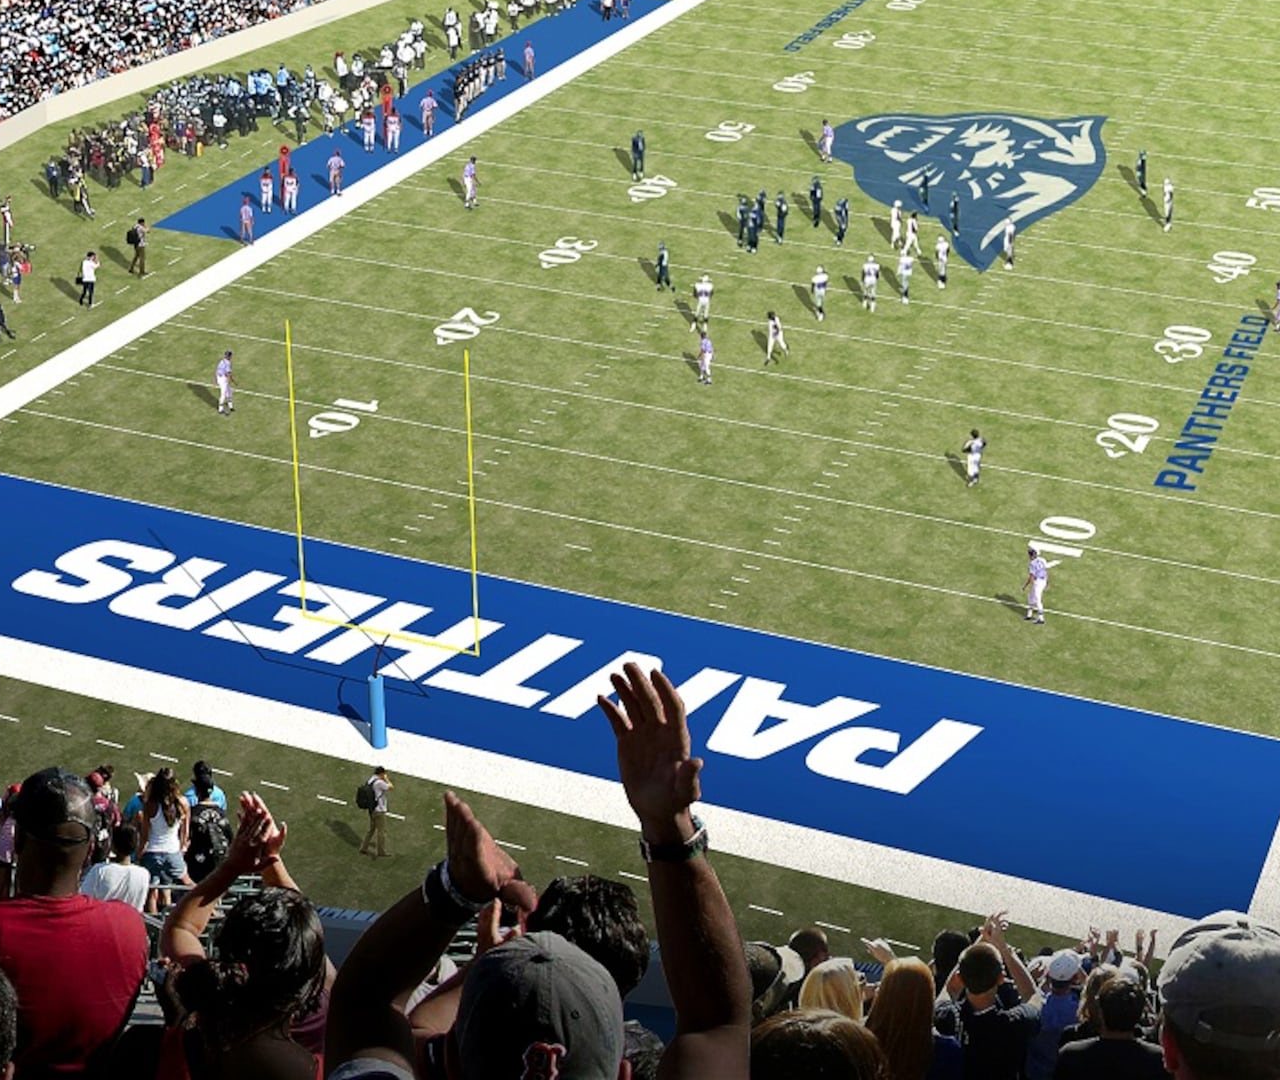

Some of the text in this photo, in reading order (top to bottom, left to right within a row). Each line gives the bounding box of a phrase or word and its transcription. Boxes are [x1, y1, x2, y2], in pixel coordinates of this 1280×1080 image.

[832, 29, 876, 50] 30
[773, 71, 816, 94] 40
[705, 120, 756, 143] 50
[627, 174, 678, 201] 40
[538, 236, 599, 265] 30
[1206, 250, 1258, 280] 40
[433, 307, 501, 341] 20
[1154, 325, 1213, 358] 30
[307, 398, 379, 433] 10
[1153, 313, 1271, 492] PANTHERS FIELD
[1095, 412, 1160, 453] 20
[1027, 516, 1097, 558] 10
[10, 538, 986, 795] PANTHERS
